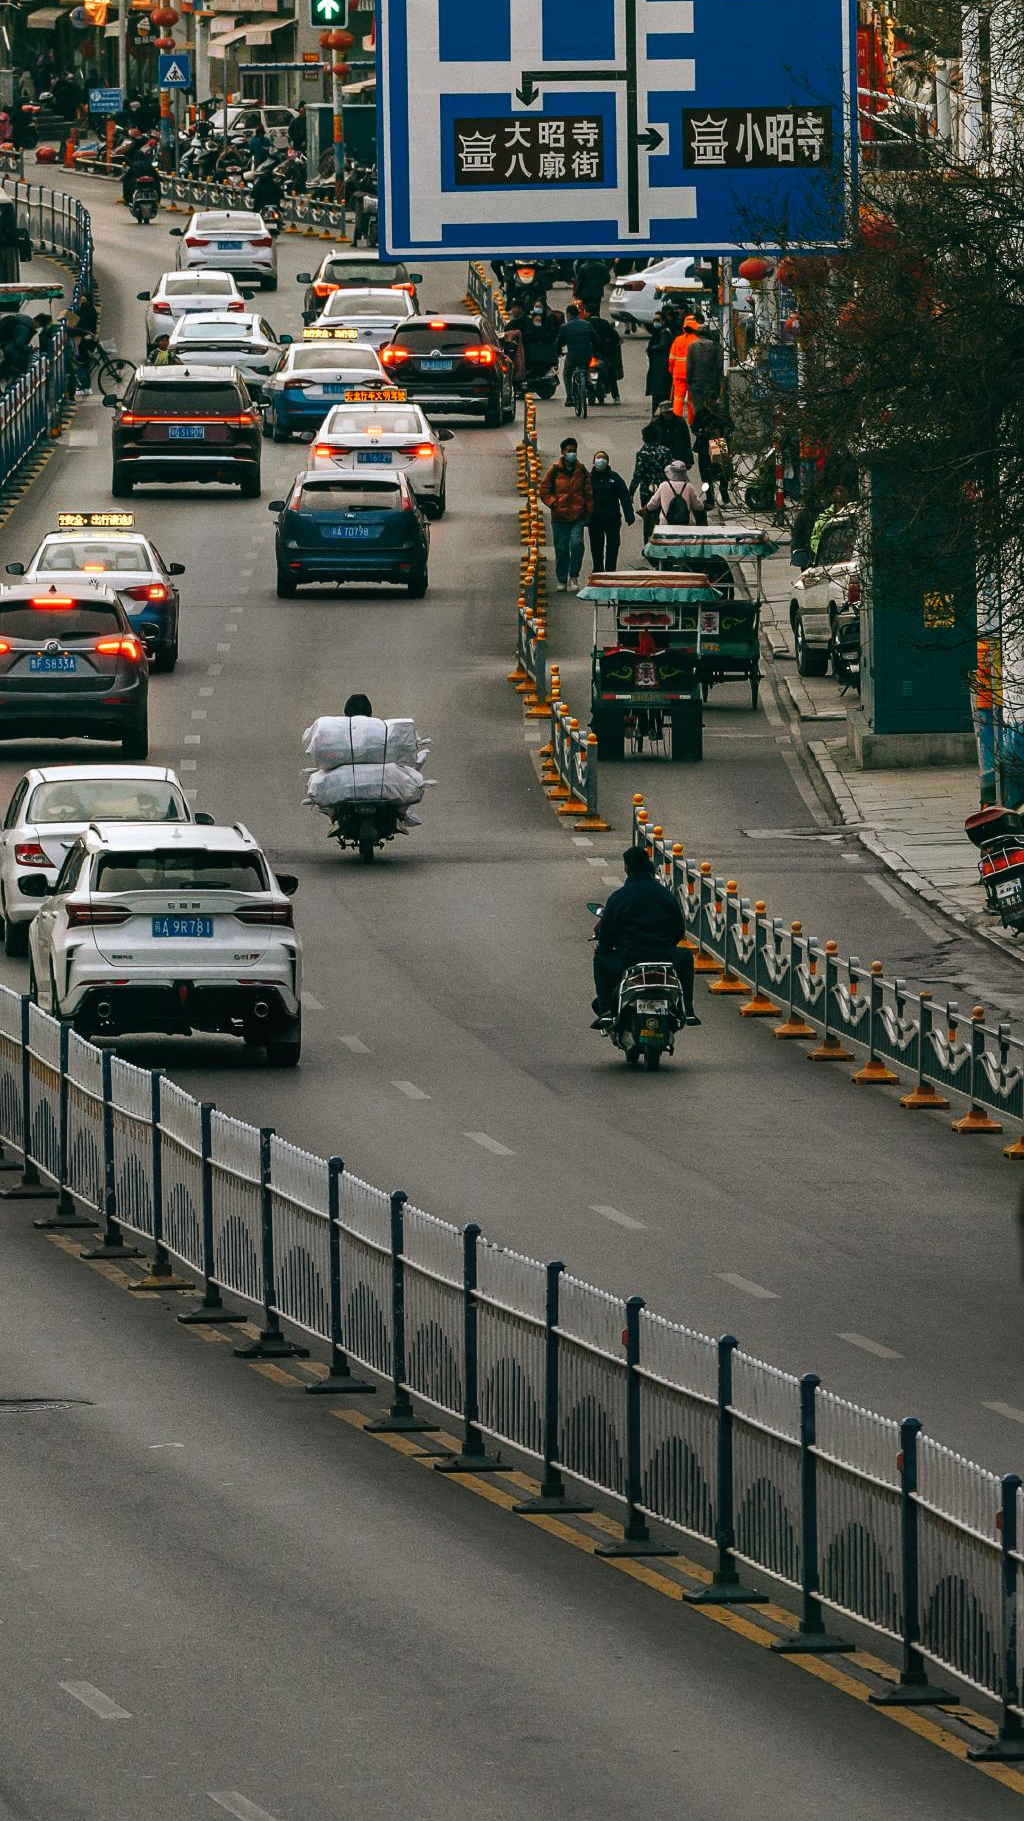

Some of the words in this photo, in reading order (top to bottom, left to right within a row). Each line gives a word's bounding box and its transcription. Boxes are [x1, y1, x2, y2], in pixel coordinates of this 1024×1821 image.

[504, 121, 600, 149] 大昭寺
[736, 113, 824, 164] 小昭寺
[504, 151, 600, 180] 八廓街
